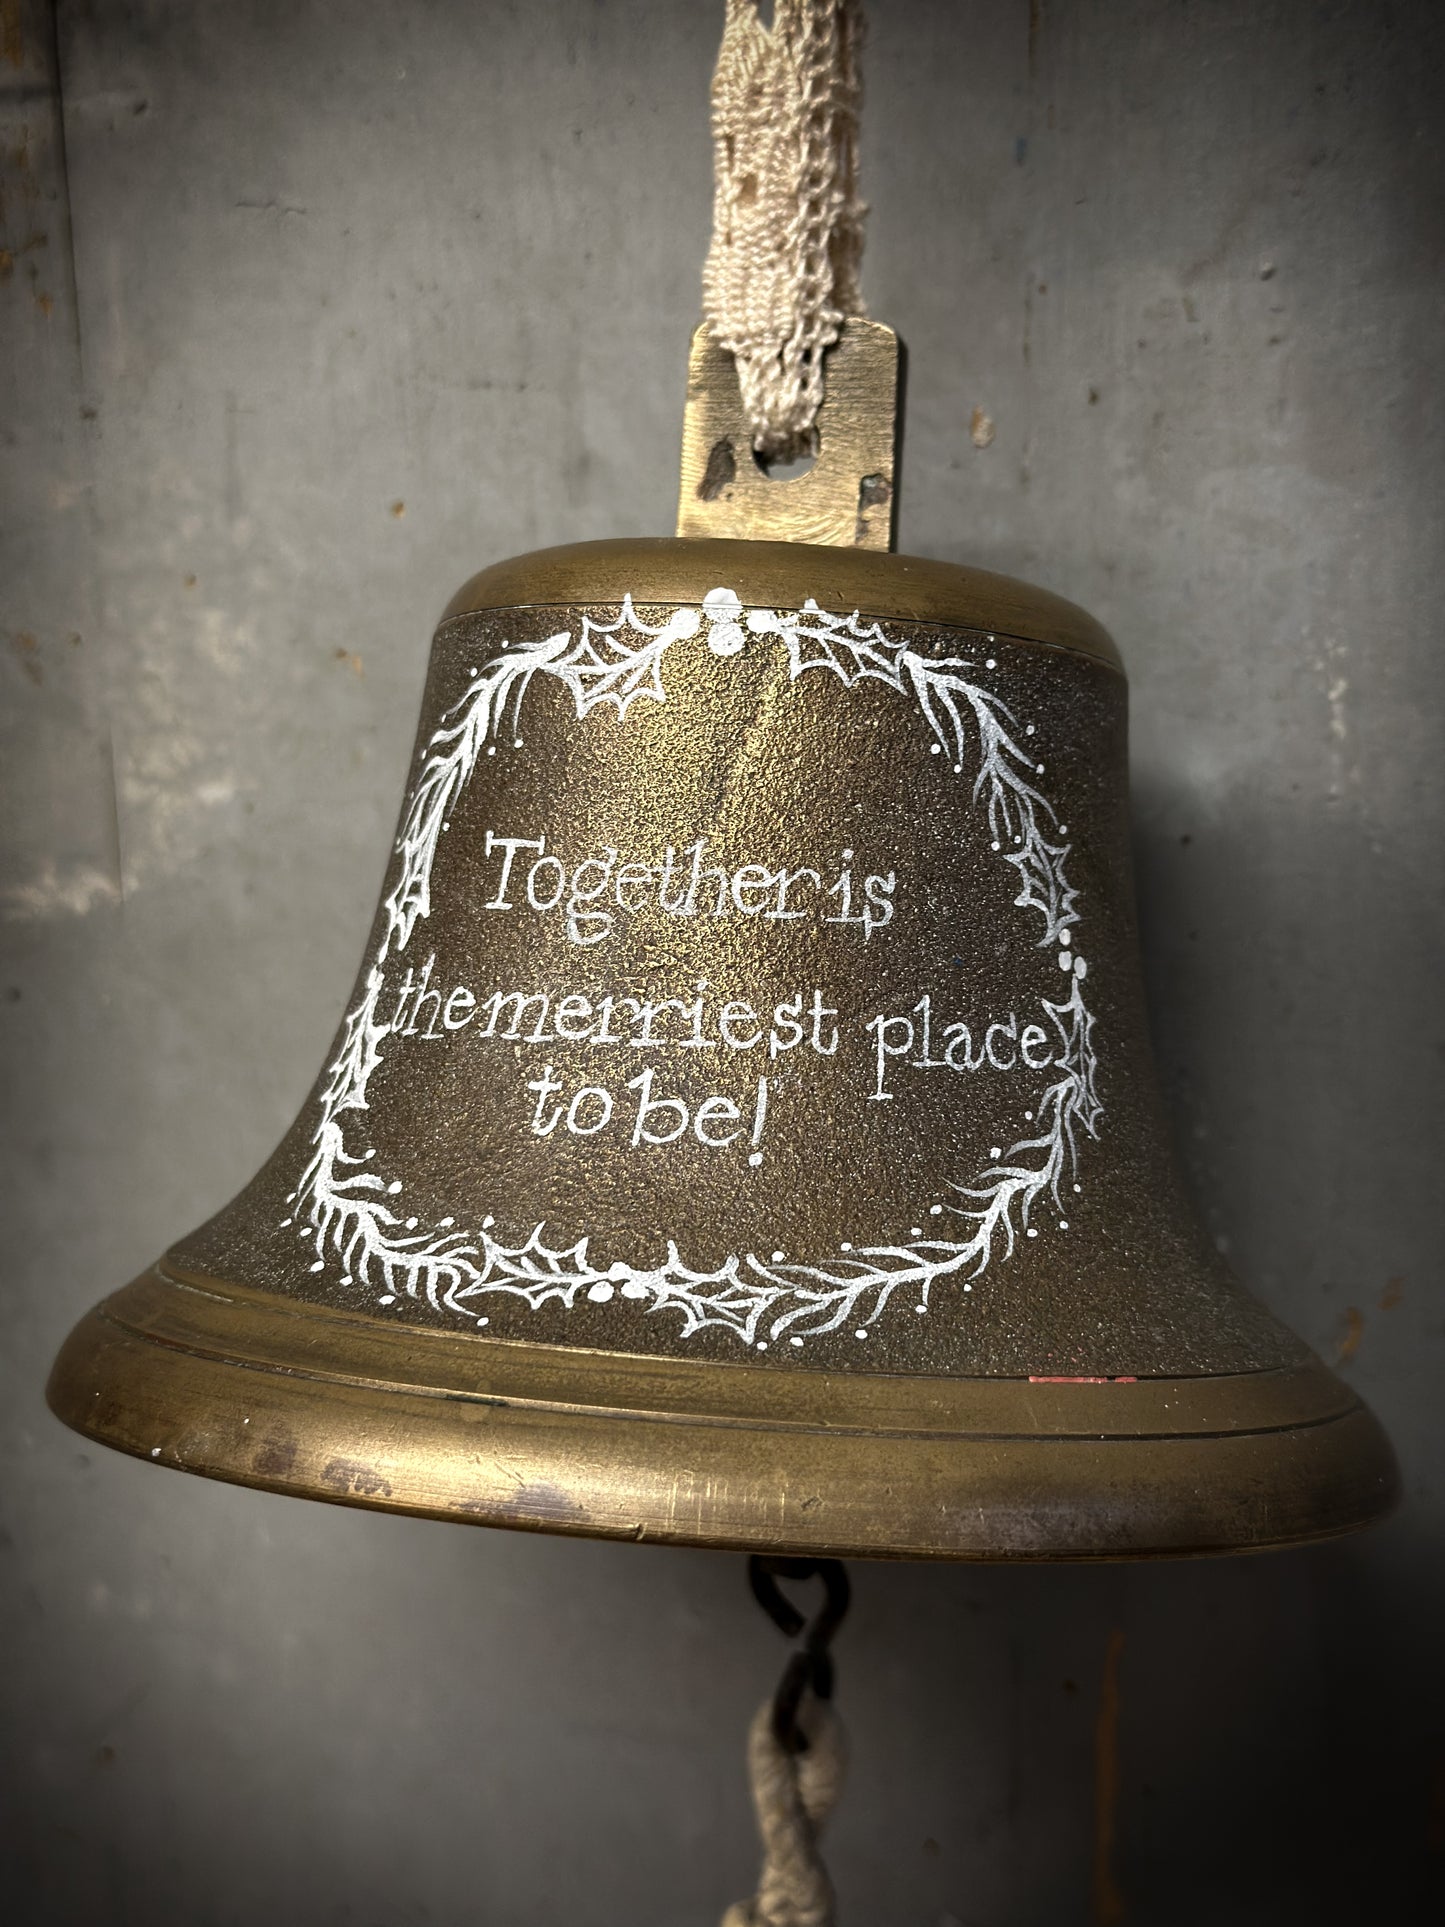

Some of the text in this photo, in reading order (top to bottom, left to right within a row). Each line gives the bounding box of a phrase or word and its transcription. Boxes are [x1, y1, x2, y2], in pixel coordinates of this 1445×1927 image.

[484, 829, 896, 945] Together is
[391, 953, 1053, 1100] the merriest place
[528, 1066, 768, 1167] to be!
